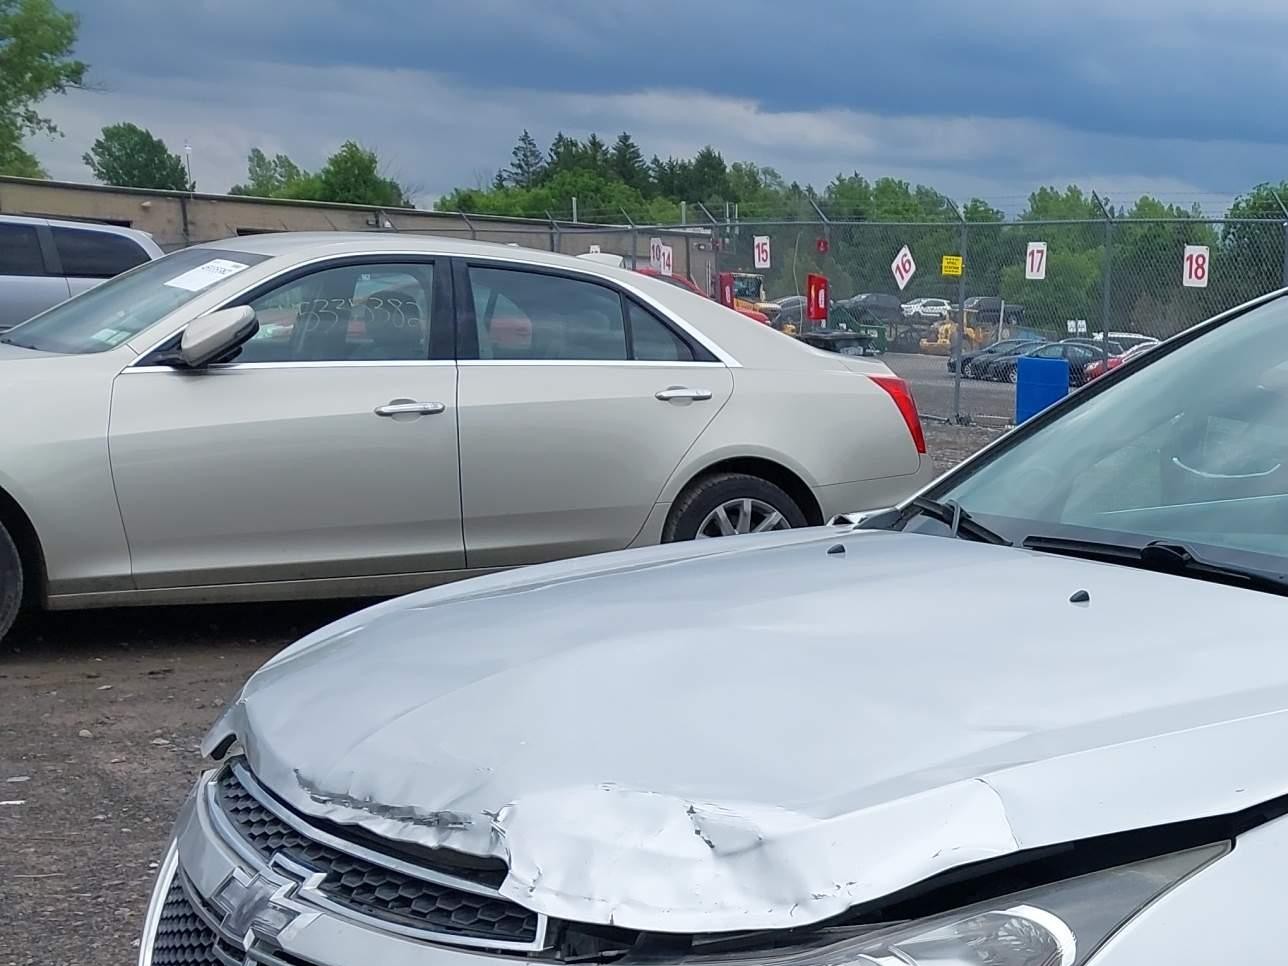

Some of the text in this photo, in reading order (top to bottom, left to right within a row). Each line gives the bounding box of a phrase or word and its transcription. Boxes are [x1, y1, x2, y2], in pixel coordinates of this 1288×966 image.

[662, 251, 671, 271] 14
[755, 242, 768, 263] 15
[1028, 249, 1044, 273] 17
[895, 253, 911, 281] 16
[1186, 253, 1206, 280] 18
